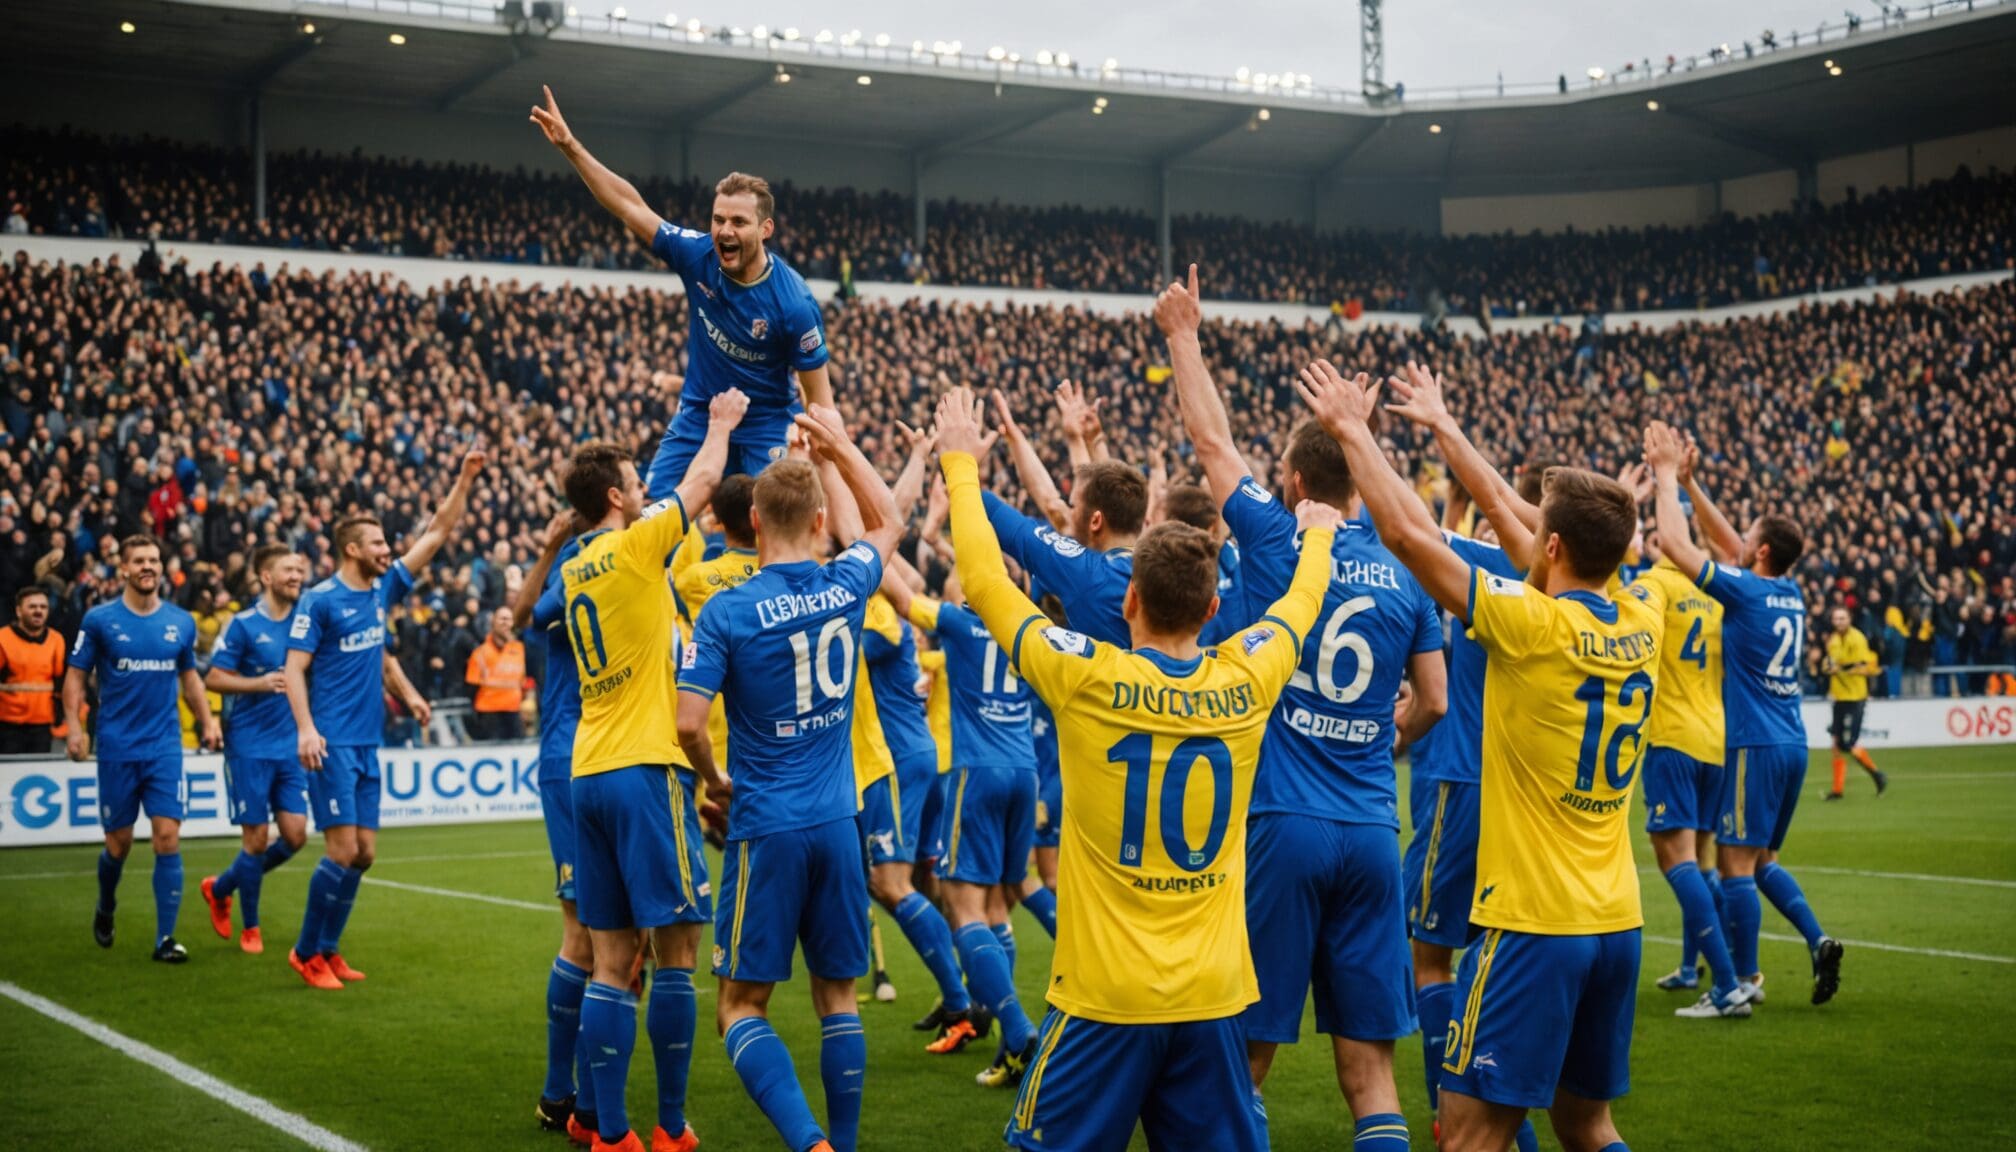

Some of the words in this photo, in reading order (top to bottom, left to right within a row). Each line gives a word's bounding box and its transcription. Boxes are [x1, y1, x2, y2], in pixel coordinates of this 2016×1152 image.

[788, 616, 854, 715] 10
[1680, 616, 1707, 671] 4
[1107, 731, 1233, 873] 10
